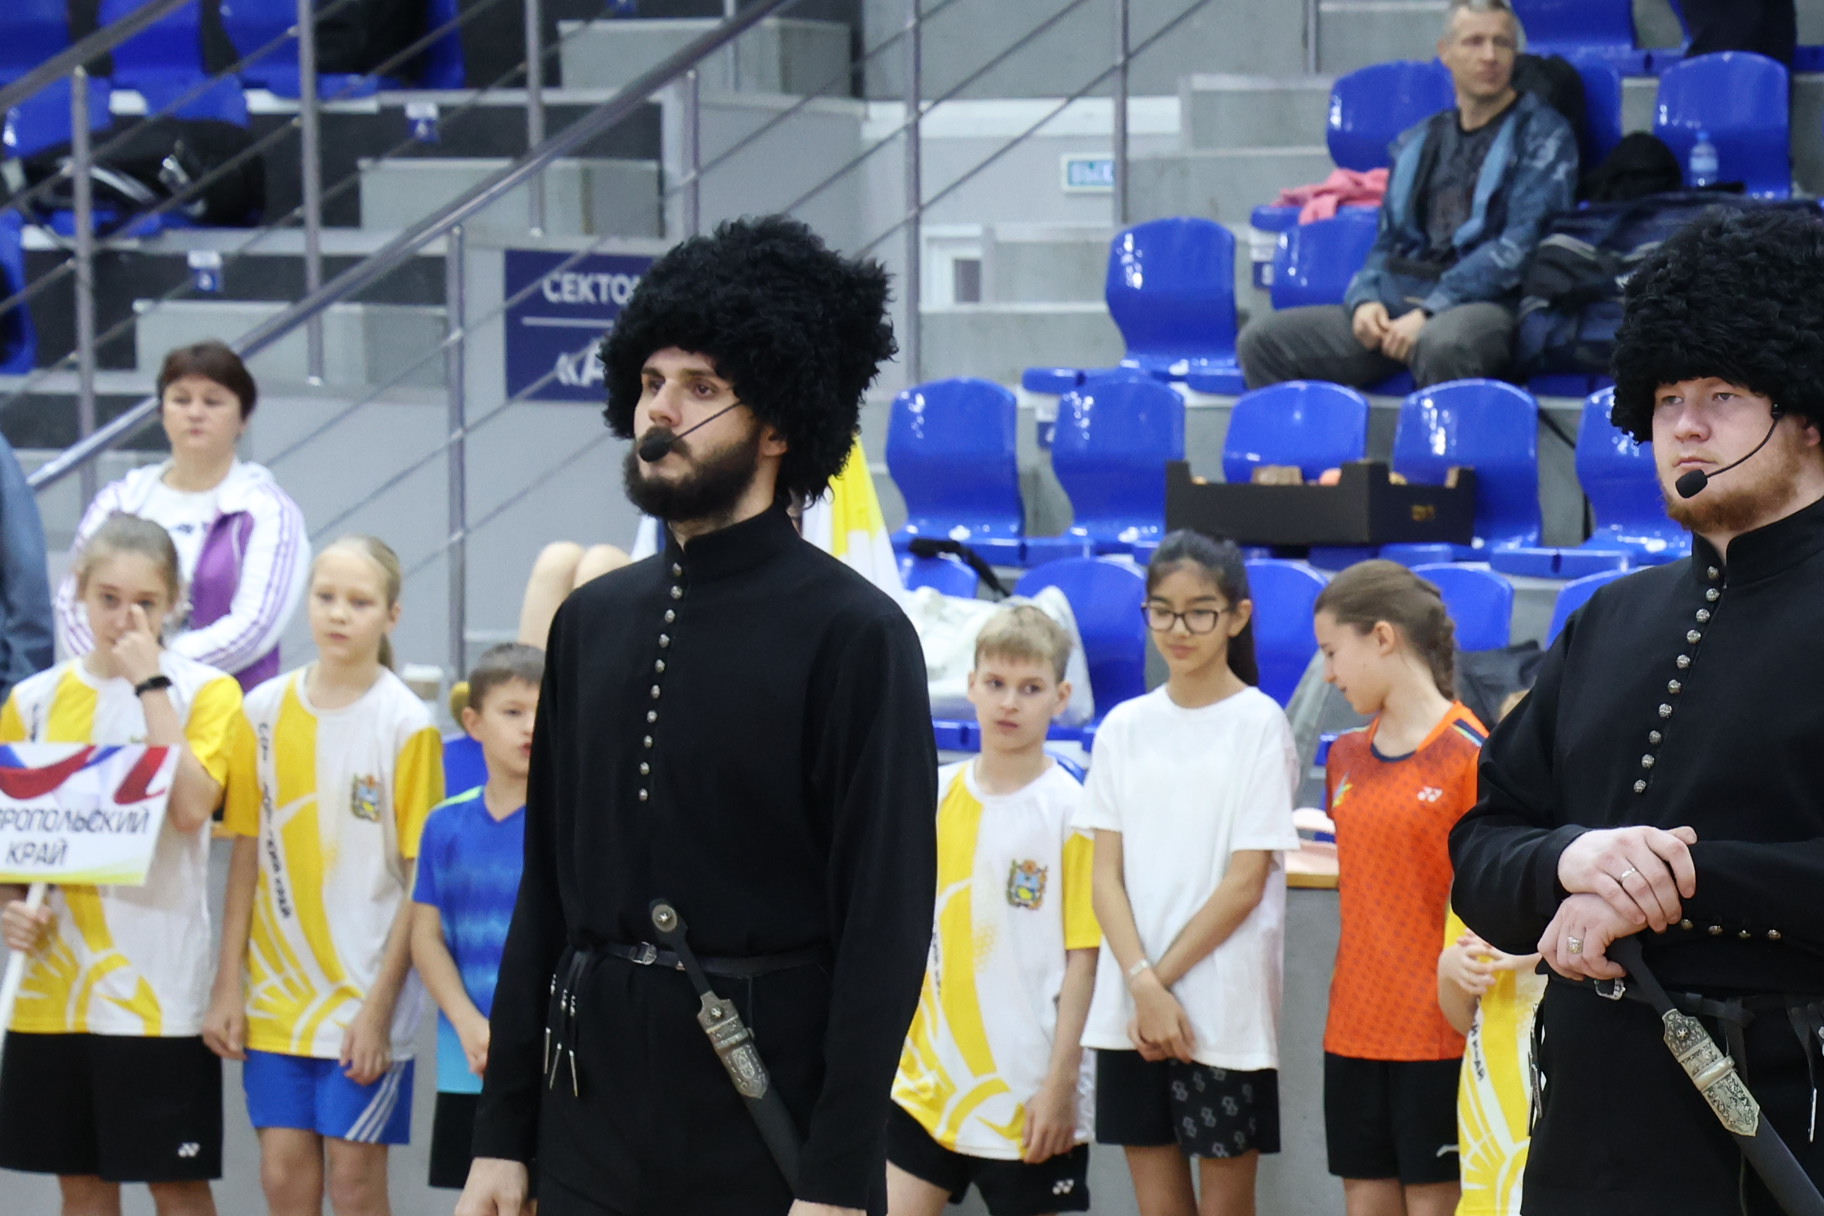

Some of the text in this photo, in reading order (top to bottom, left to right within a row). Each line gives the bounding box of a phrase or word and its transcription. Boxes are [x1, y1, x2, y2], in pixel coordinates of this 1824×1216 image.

[542, 265, 640, 304] СЕКТО
[0, 806, 150, 834] РОПОЛЬСКИЙ
[5, 837, 68, 866] КРАЙ
